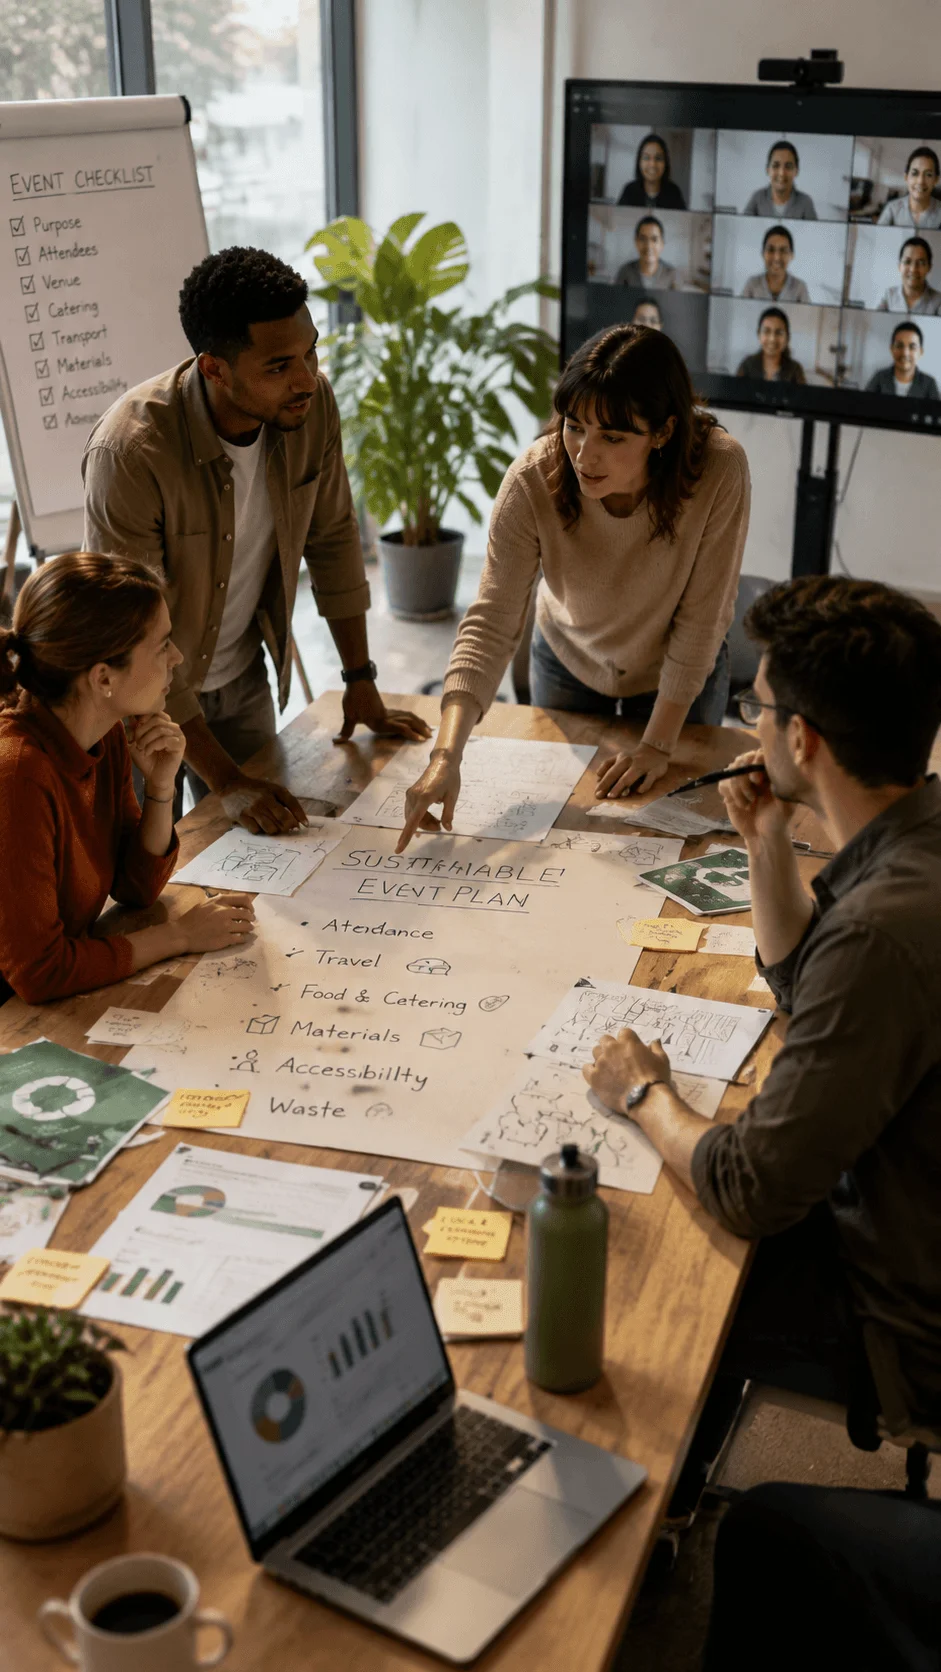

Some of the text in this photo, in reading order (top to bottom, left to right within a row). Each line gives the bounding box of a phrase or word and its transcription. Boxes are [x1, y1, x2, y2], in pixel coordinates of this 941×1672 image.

[10, 165, 153, 194] EVENT CHECKLIST
[33, 216, 82, 237] Purpose
[39, 242, 99, 262] Attendees
[42, 275, 81, 290] Venue
[48, 302, 99, 318] Catering
[51, 324, 107, 347] Transport
[357, 878, 530, 908] EVENT PLAN
[316, 949, 381, 968] Travel
[300, 983, 348, 1001] Food
[355, 988, 370, 1003] &
[290, 1020, 400, 1043] Materials
[269, 1096, 347, 1118] Waste
